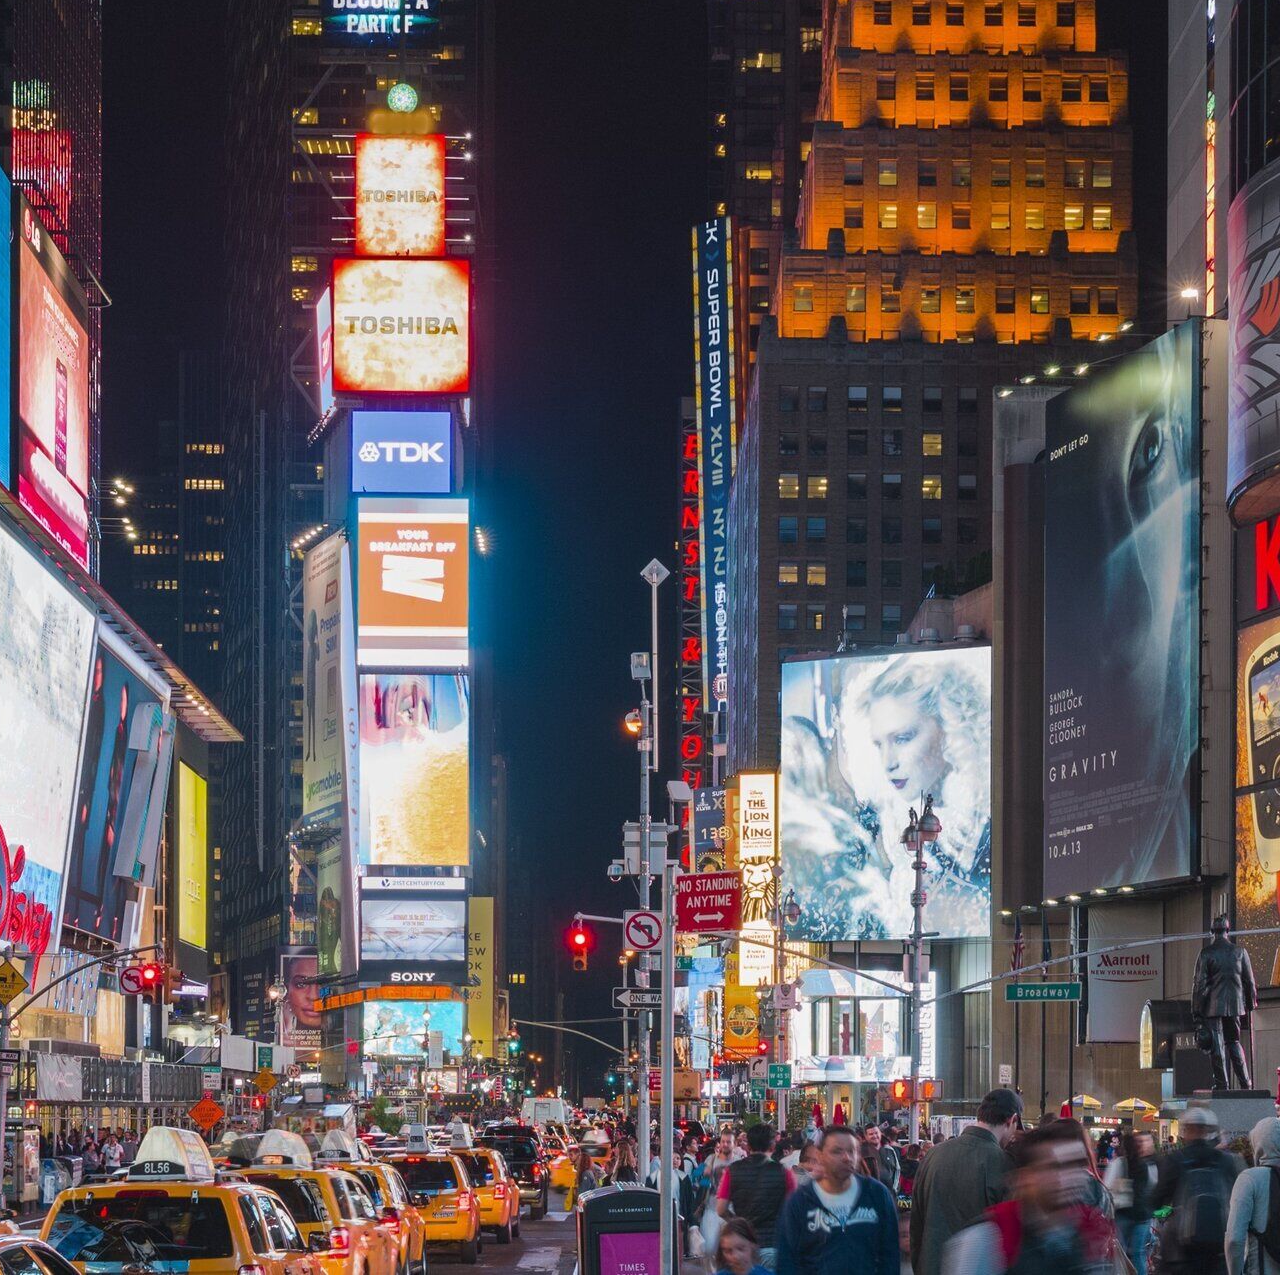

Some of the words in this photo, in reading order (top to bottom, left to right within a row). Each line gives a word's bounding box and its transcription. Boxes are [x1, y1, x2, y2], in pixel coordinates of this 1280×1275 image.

[347, 14, 389, 33] PART
[363, 190, 438, 203] TOSHIBA
[705, 267, 721, 348] SUPER
[344, 316, 459, 336] TOSHIBA
[707, 352, 722, 418] BOWL
[380, 442, 444, 462] TDK
[1050, 445, 1067, 461] DON'T
[1068, 439, 1078, 452] LET
[1079, 434, 1089, 446] GO
[397, 530, 429, 540] YOUR
[369, 542, 433, 553] BREAKFAST
[1263, 650, 1280, 667] Kodak
[1049, 688, 1074, 703] SANDRA
[1049, 695, 1083, 715] BULLOCK
[1049, 717, 1075, 733] GEORGE
[1049, 724, 1087, 745] CLOONEY
[1049, 750, 1117, 782] GRAVITY
[747, 799, 766, 808] THE
[744, 810, 770, 822] LION
[742, 826, 772, 840] KING
[1048, 840, 1081, 859] 10.4.13
[679, 880, 692, 893] NO
[696, 877, 739, 893] STANDING
[686, 894, 732, 908] ANYTIME
[1097, 954, 1150, 967] Marriott
[391, 972, 435, 982] SONY
[629, 993, 646, 1002] ONE
[1017, 987, 1070, 999] Broadway
[144, 1162, 170, 1173] 8L56
[619, 1263, 646, 1271] TIMES
